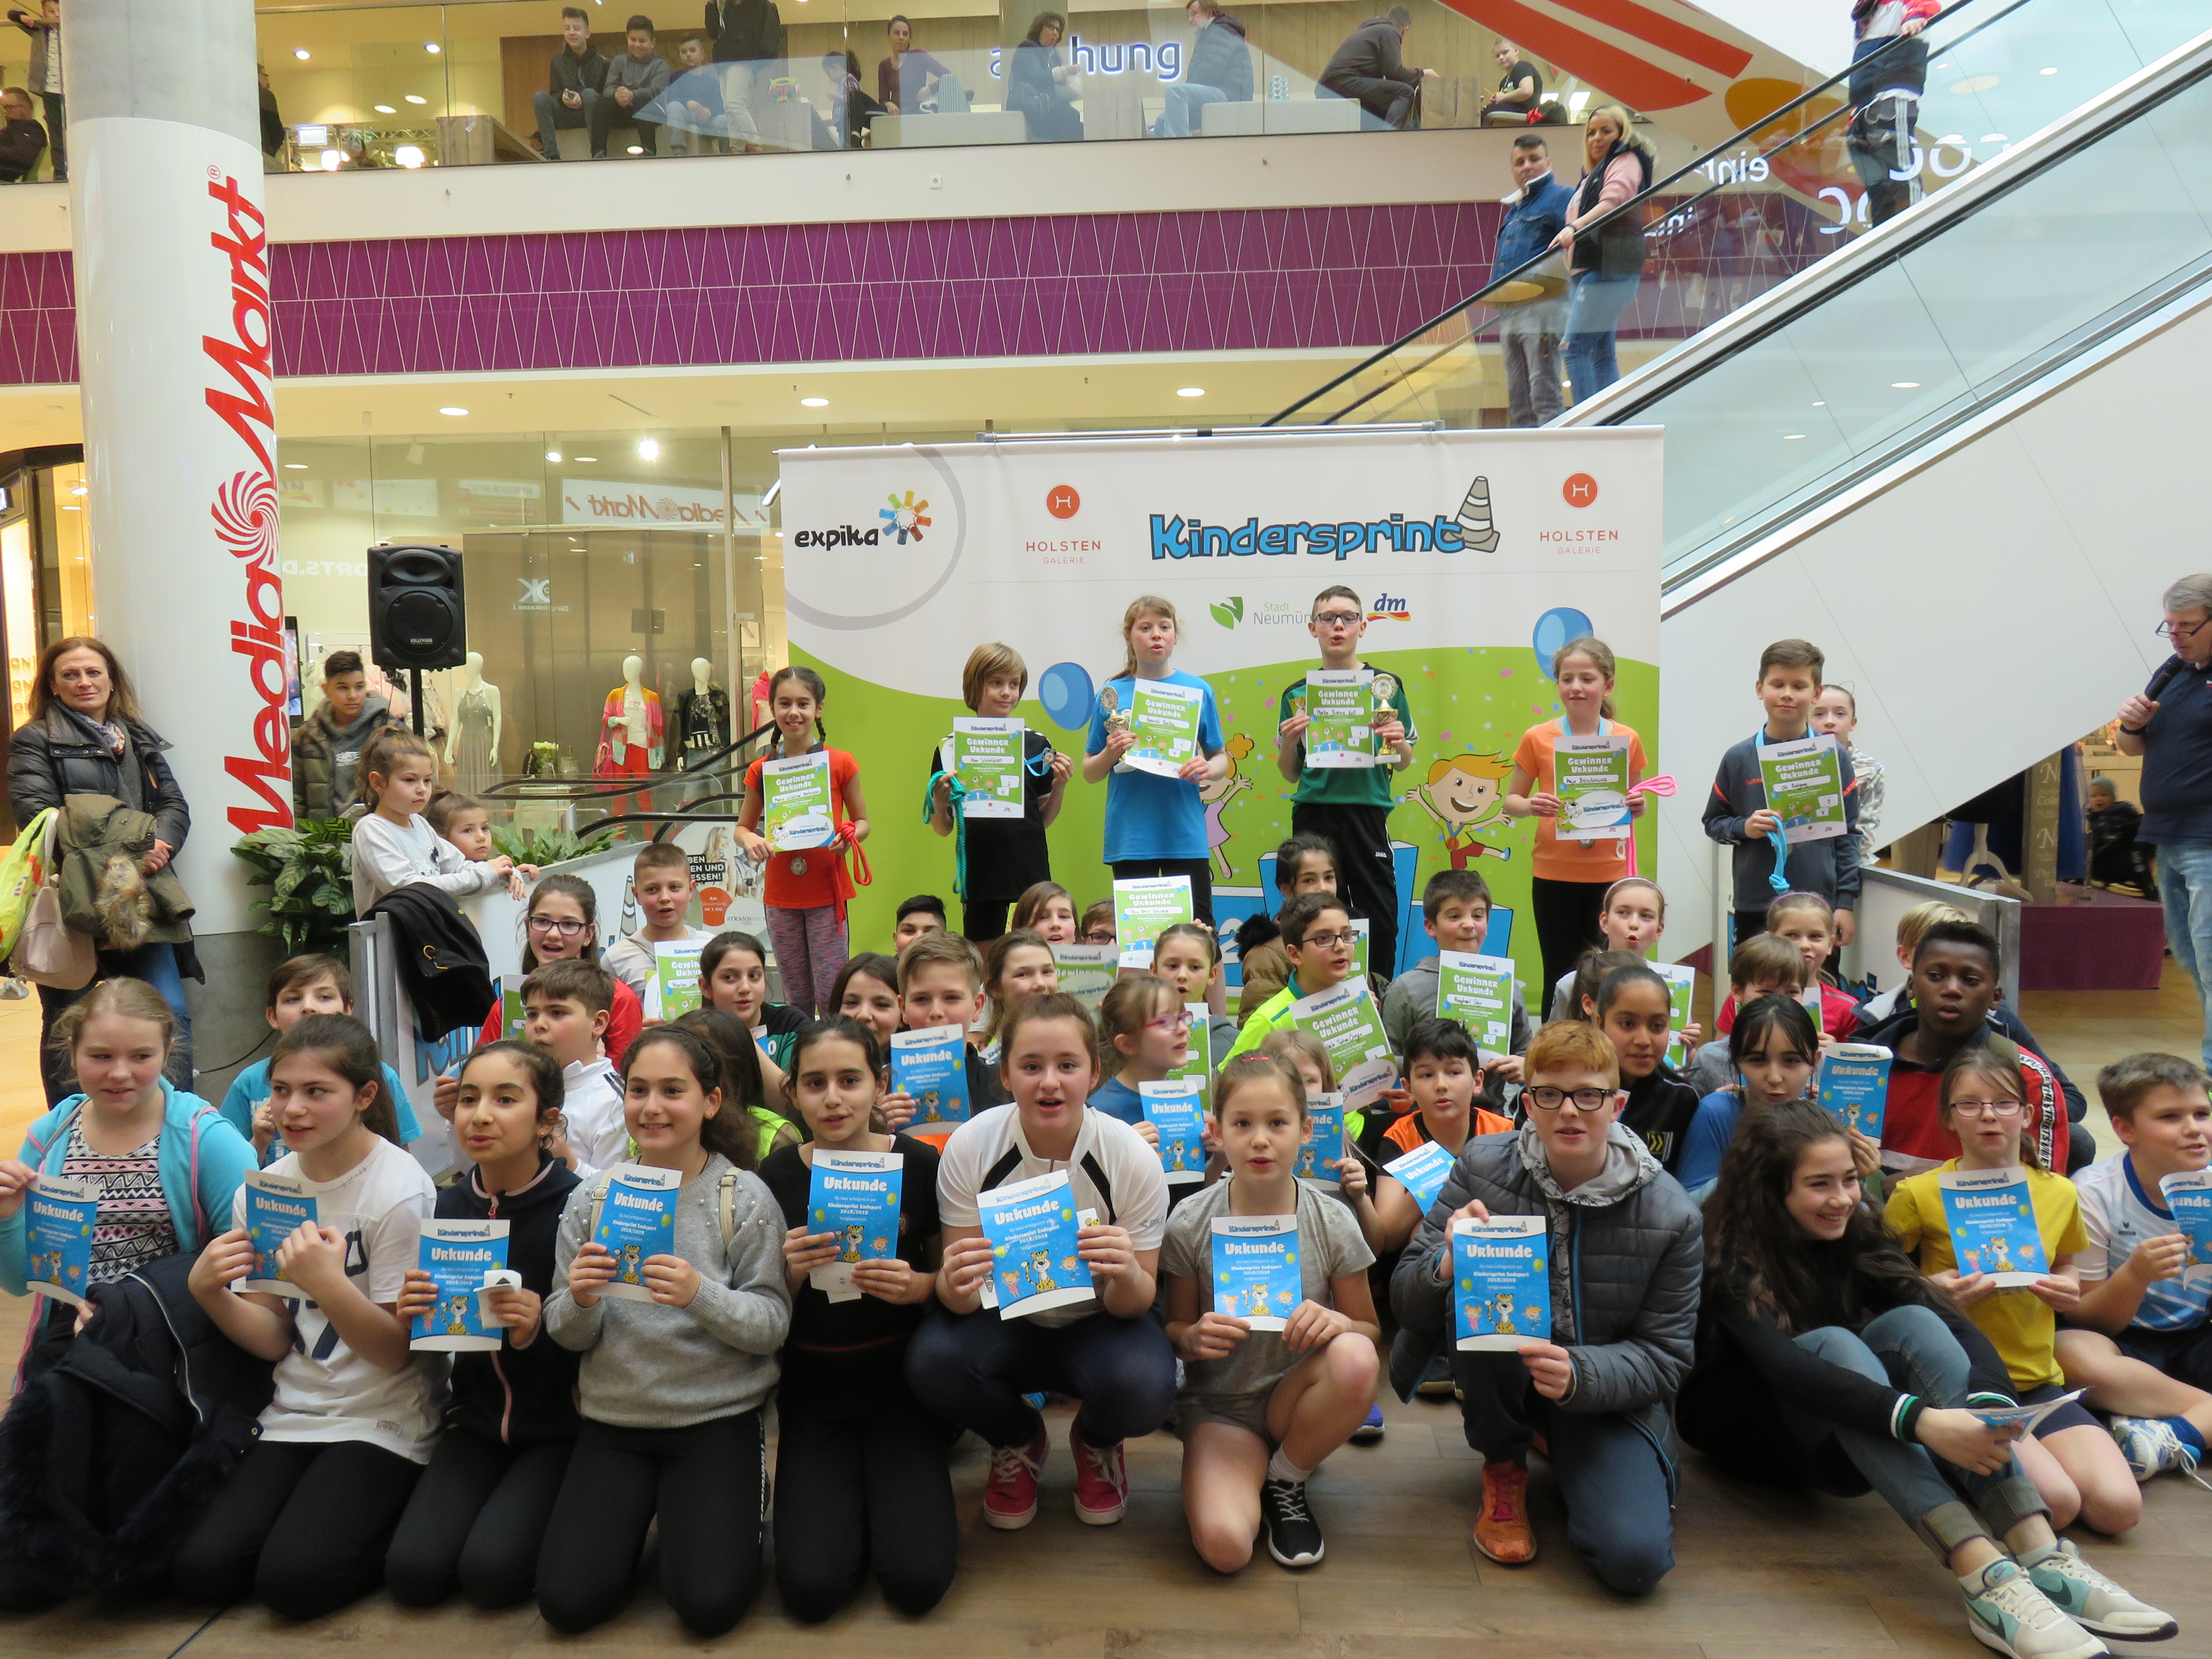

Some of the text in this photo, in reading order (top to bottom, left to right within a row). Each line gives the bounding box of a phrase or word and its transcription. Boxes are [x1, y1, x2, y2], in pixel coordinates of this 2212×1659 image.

[794, 524, 879, 551] expika
[1149, 513, 1464, 561] Kindersprint
[1539, 530, 1618, 543] HOLSTEN
[1026, 540, 1101, 552] HOLSTEN
[1557, 546, 1601, 554] GALERIE
[1264, 602, 1290, 611] Stadt
[1374, 593, 1406, 611] dm
